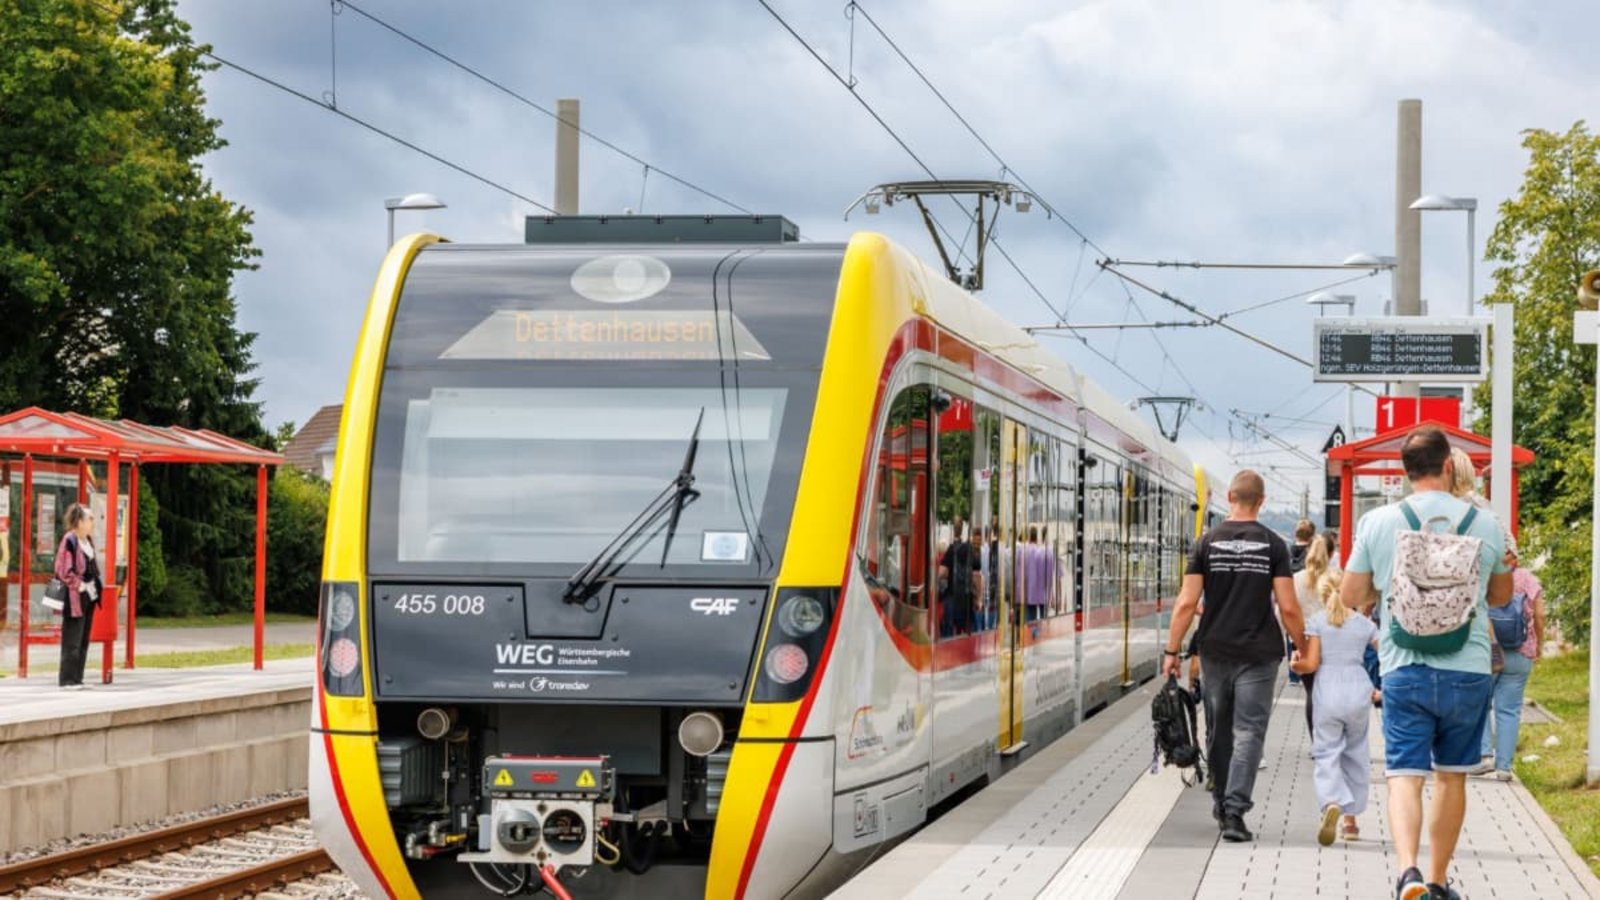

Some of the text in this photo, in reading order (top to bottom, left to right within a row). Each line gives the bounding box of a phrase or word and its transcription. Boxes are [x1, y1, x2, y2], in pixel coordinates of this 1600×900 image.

[515, 312, 714, 342] Dettenhausen
[1394, 334, 1453, 342] Dettenhausen
[1394, 344, 1453, 352] Dettenhausen
[1394, 354, 1453, 362] Dettenhausen
[1381, 400, 1394, 428] 1
[394, 594, 485, 616] 455 008
[690, 597, 740, 616] CAF
[495, 644, 554, 666] WEG
[558, 648, 630, 658] Württembergische
[492, 681, 525, 690] Wir sind
[548, 681, 590, 691] transdev
